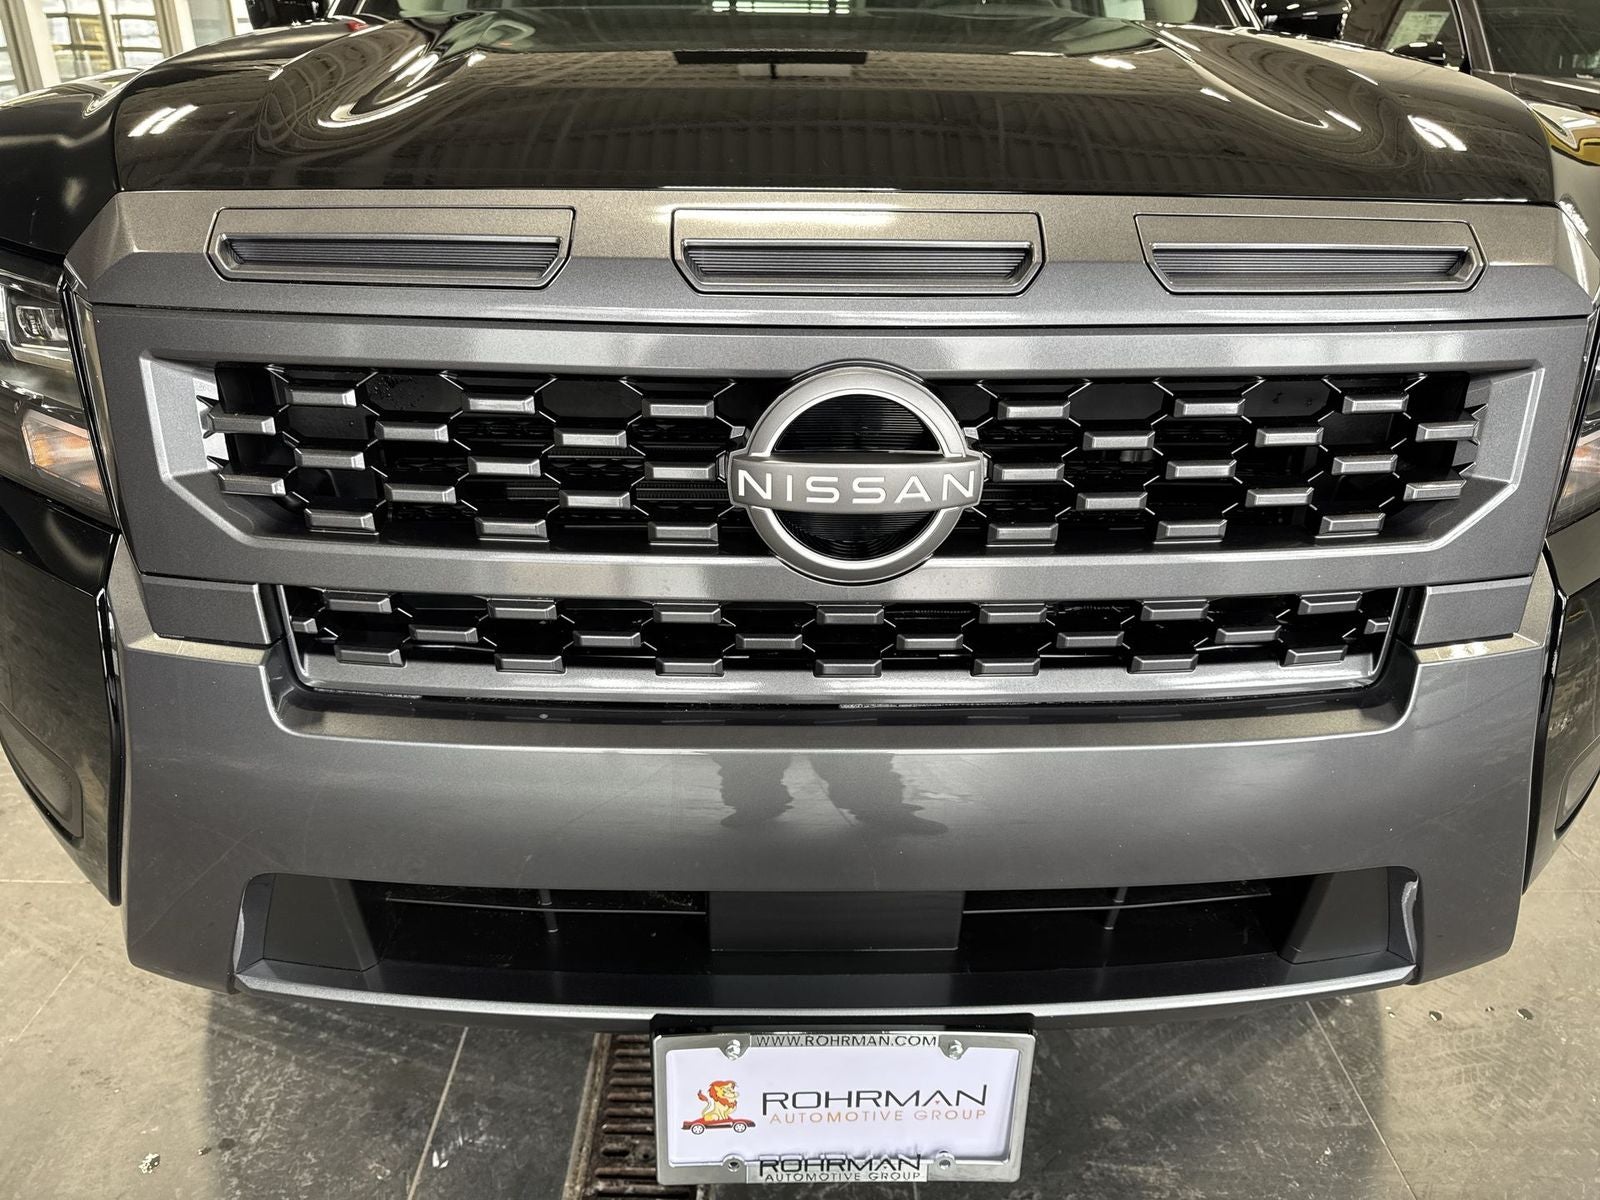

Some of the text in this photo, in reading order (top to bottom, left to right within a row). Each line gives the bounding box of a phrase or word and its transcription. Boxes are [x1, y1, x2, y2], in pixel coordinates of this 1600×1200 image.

[738, 469, 975, 504] NISSAN
[756, 1035, 937, 1047] WWW.ROHRMAN.COM
[762, 1084, 987, 1116] ROHRMAN
[769, 1109, 987, 1124] AUTOMOTIVE GROUP
[760, 1154, 921, 1177] ROHRMAN
[765, 1171, 922, 1182] AUTOMOTIVE GROUP
